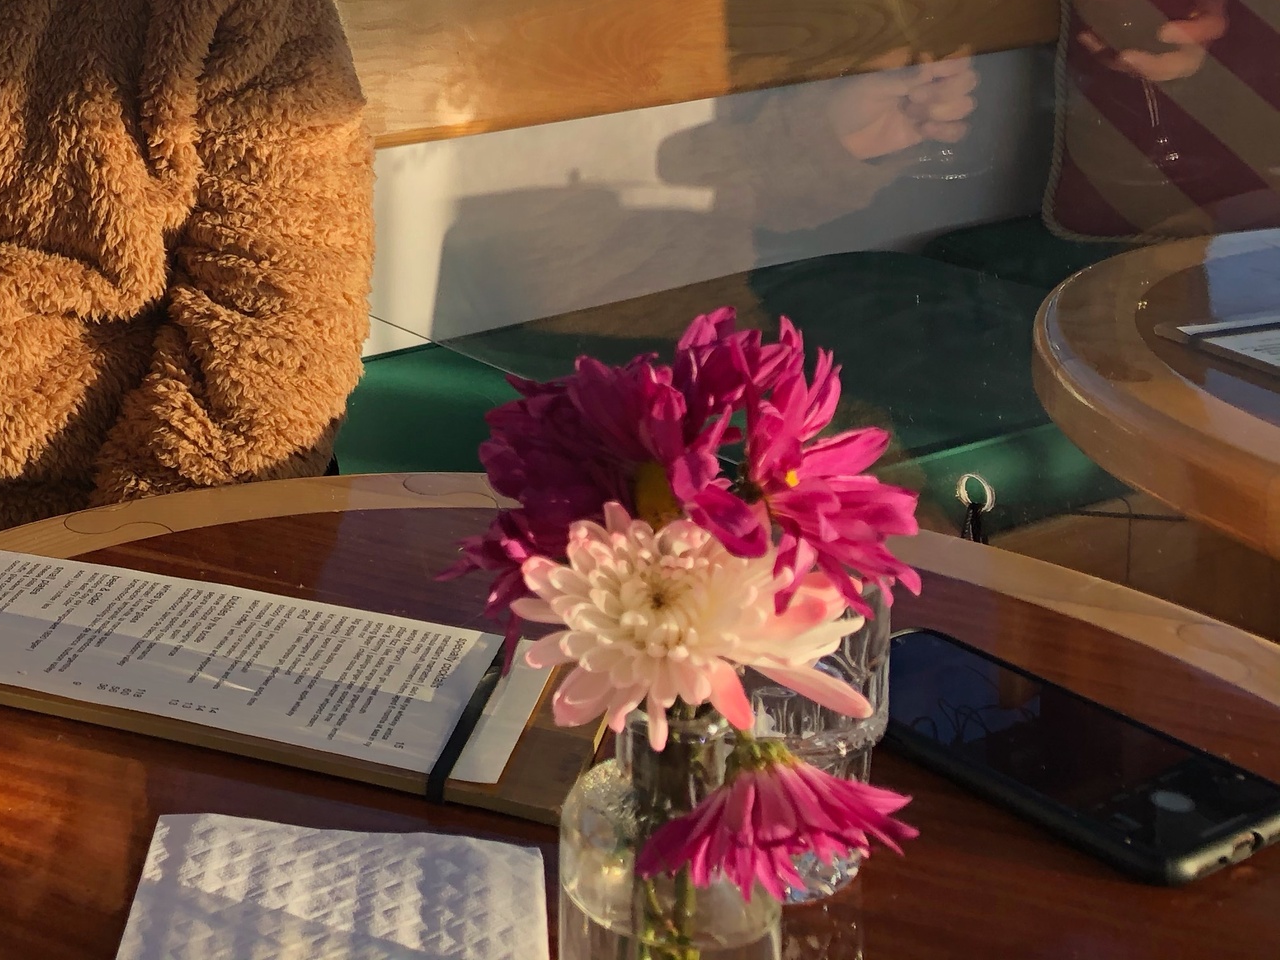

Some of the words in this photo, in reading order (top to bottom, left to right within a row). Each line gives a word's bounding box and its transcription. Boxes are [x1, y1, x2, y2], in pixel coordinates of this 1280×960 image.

[46, 567, 64, 580] small
[29, 580, 50, 595] plates
[105, 576, 122, 587] beer
[153, 585, 172, 599] wines
[217, 595, 242, 616] bubbles
[297, 609, 310, 620] and
[444, 638, 467, 662] specialty
[430, 663, 452, 689] cocktails
